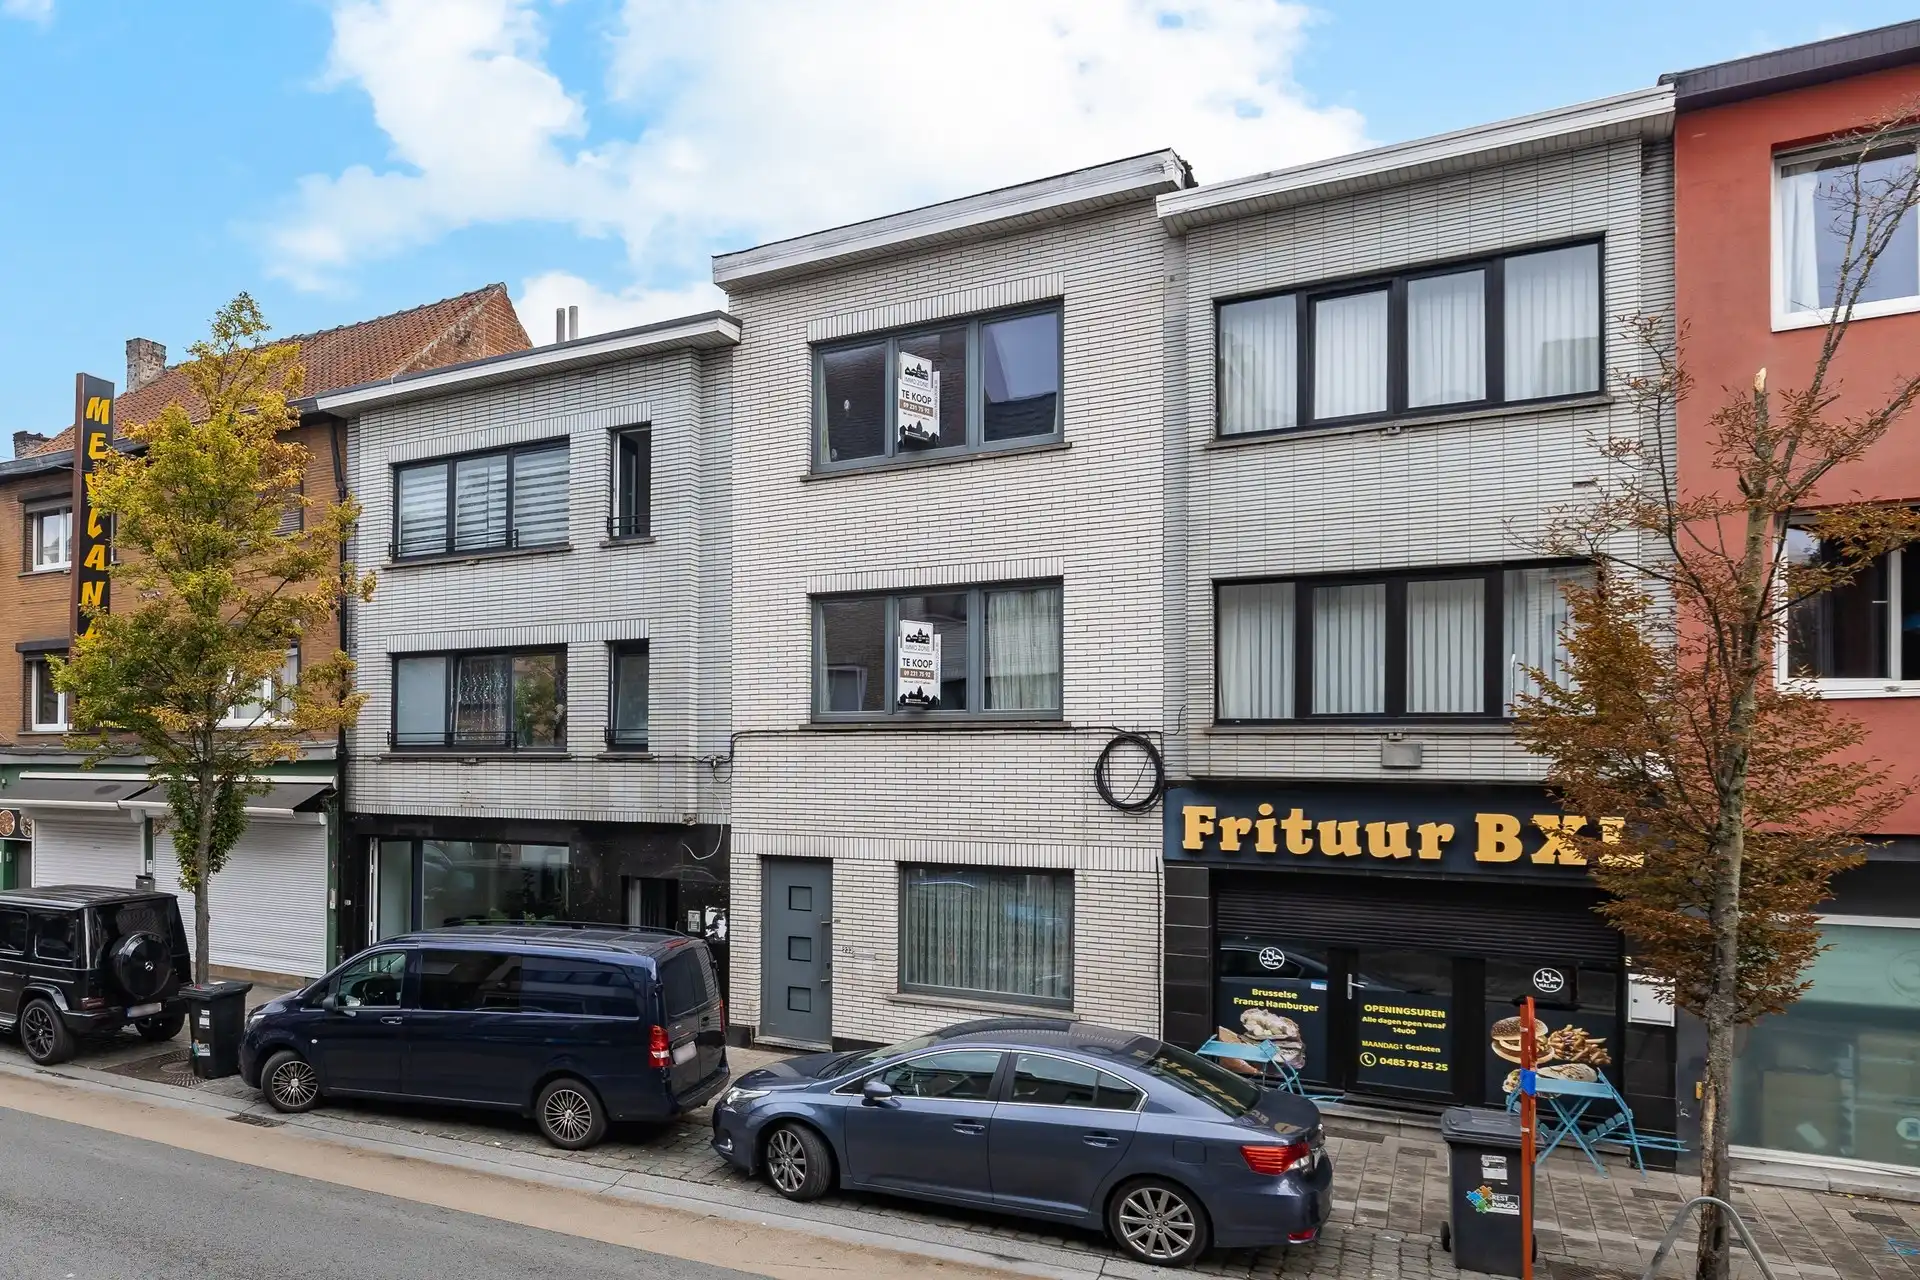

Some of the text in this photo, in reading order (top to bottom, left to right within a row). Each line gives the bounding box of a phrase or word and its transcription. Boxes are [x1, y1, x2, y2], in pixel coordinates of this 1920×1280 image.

[902, 390, 932, 404] TE KOOP
[902, 658, 933, 668] TE KOOP
[1181, 803, 1455, 860] Frituur
[1252, 988, 1298, 999] Brusselse
[1233, 997, 1319, 1012] Franse Hamburger
[1364, 1004, 1446, 1018] OPENINGSUREN
[1405, 1044, 1441, 1053] Gesloten
[1380, 1057, 1448, 1071] 0485 78 25 25
